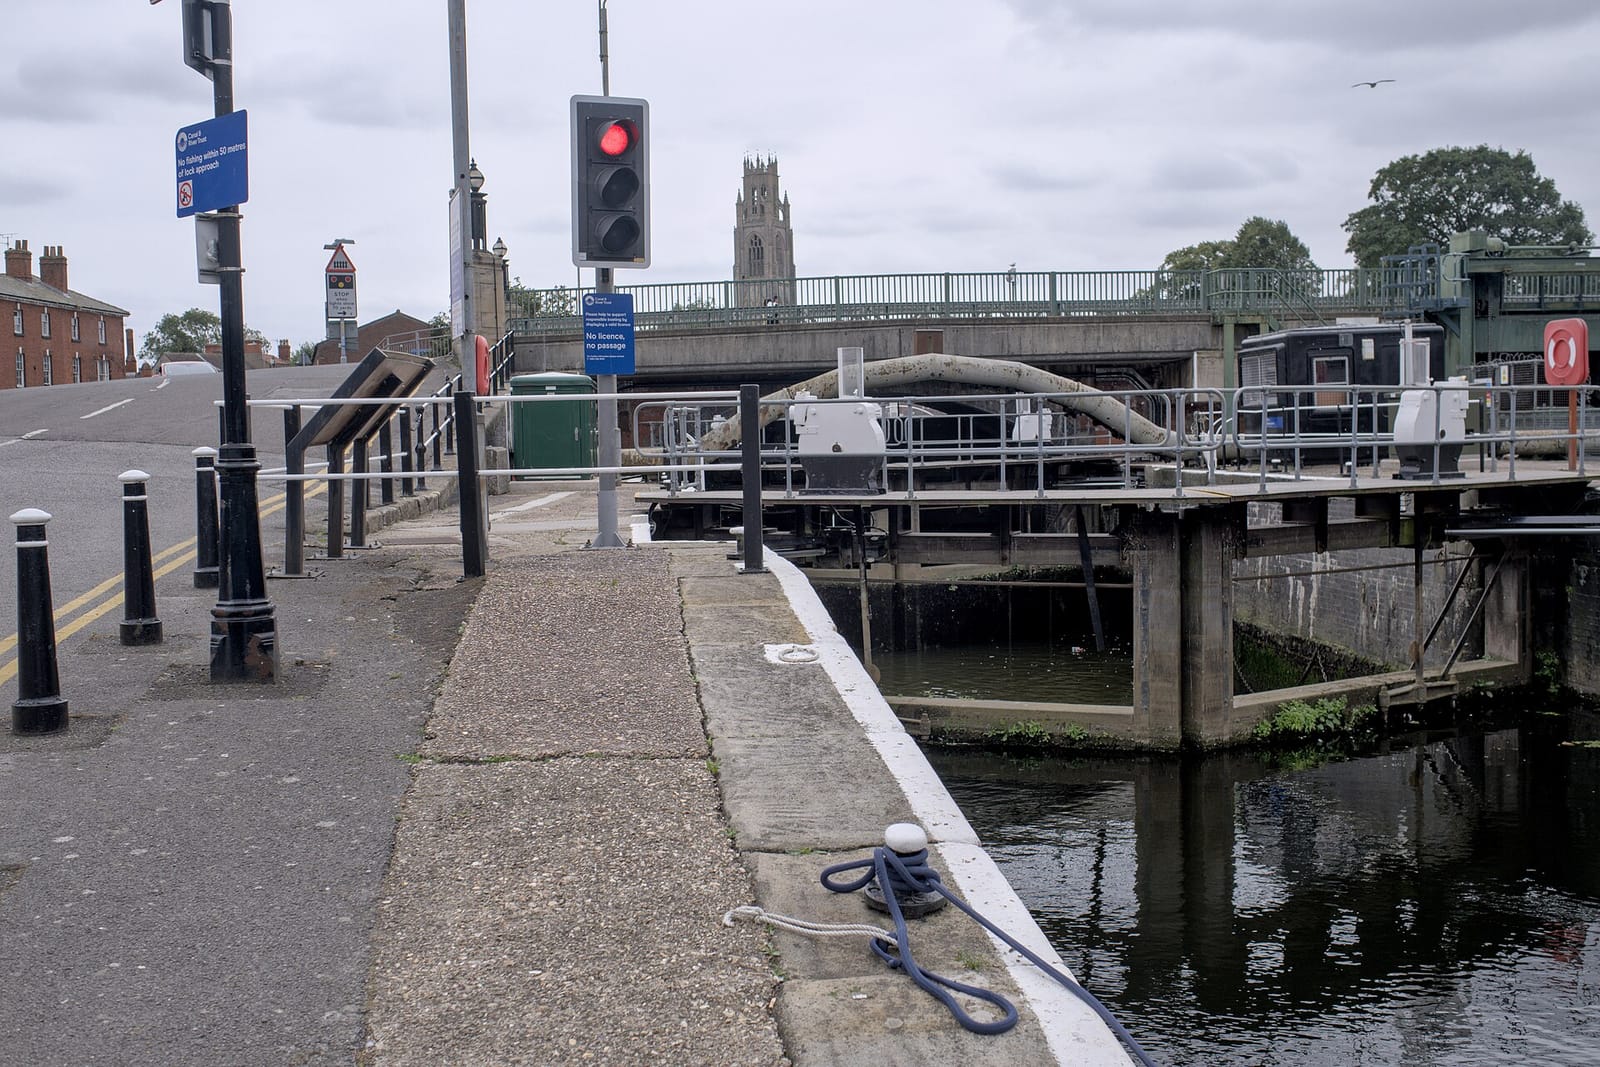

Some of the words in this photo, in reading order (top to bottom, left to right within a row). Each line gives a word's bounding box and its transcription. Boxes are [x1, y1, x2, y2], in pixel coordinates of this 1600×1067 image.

[188, 130, 198, 139] Canal
[198, 136, 208, 144] Trust
[178, 158, 185, 167] No
[186, 154, 203, 165] fishing
[203, 148, 219, 160] within
[219, 146, 227, 156] 50
[227, 142, 246, 153] metres
[178, 168, 184, 178] of
[185, 166, 195, 176] lock
[196, 160, 219, 175] approach
[598, 332, 626, 341] licence,
